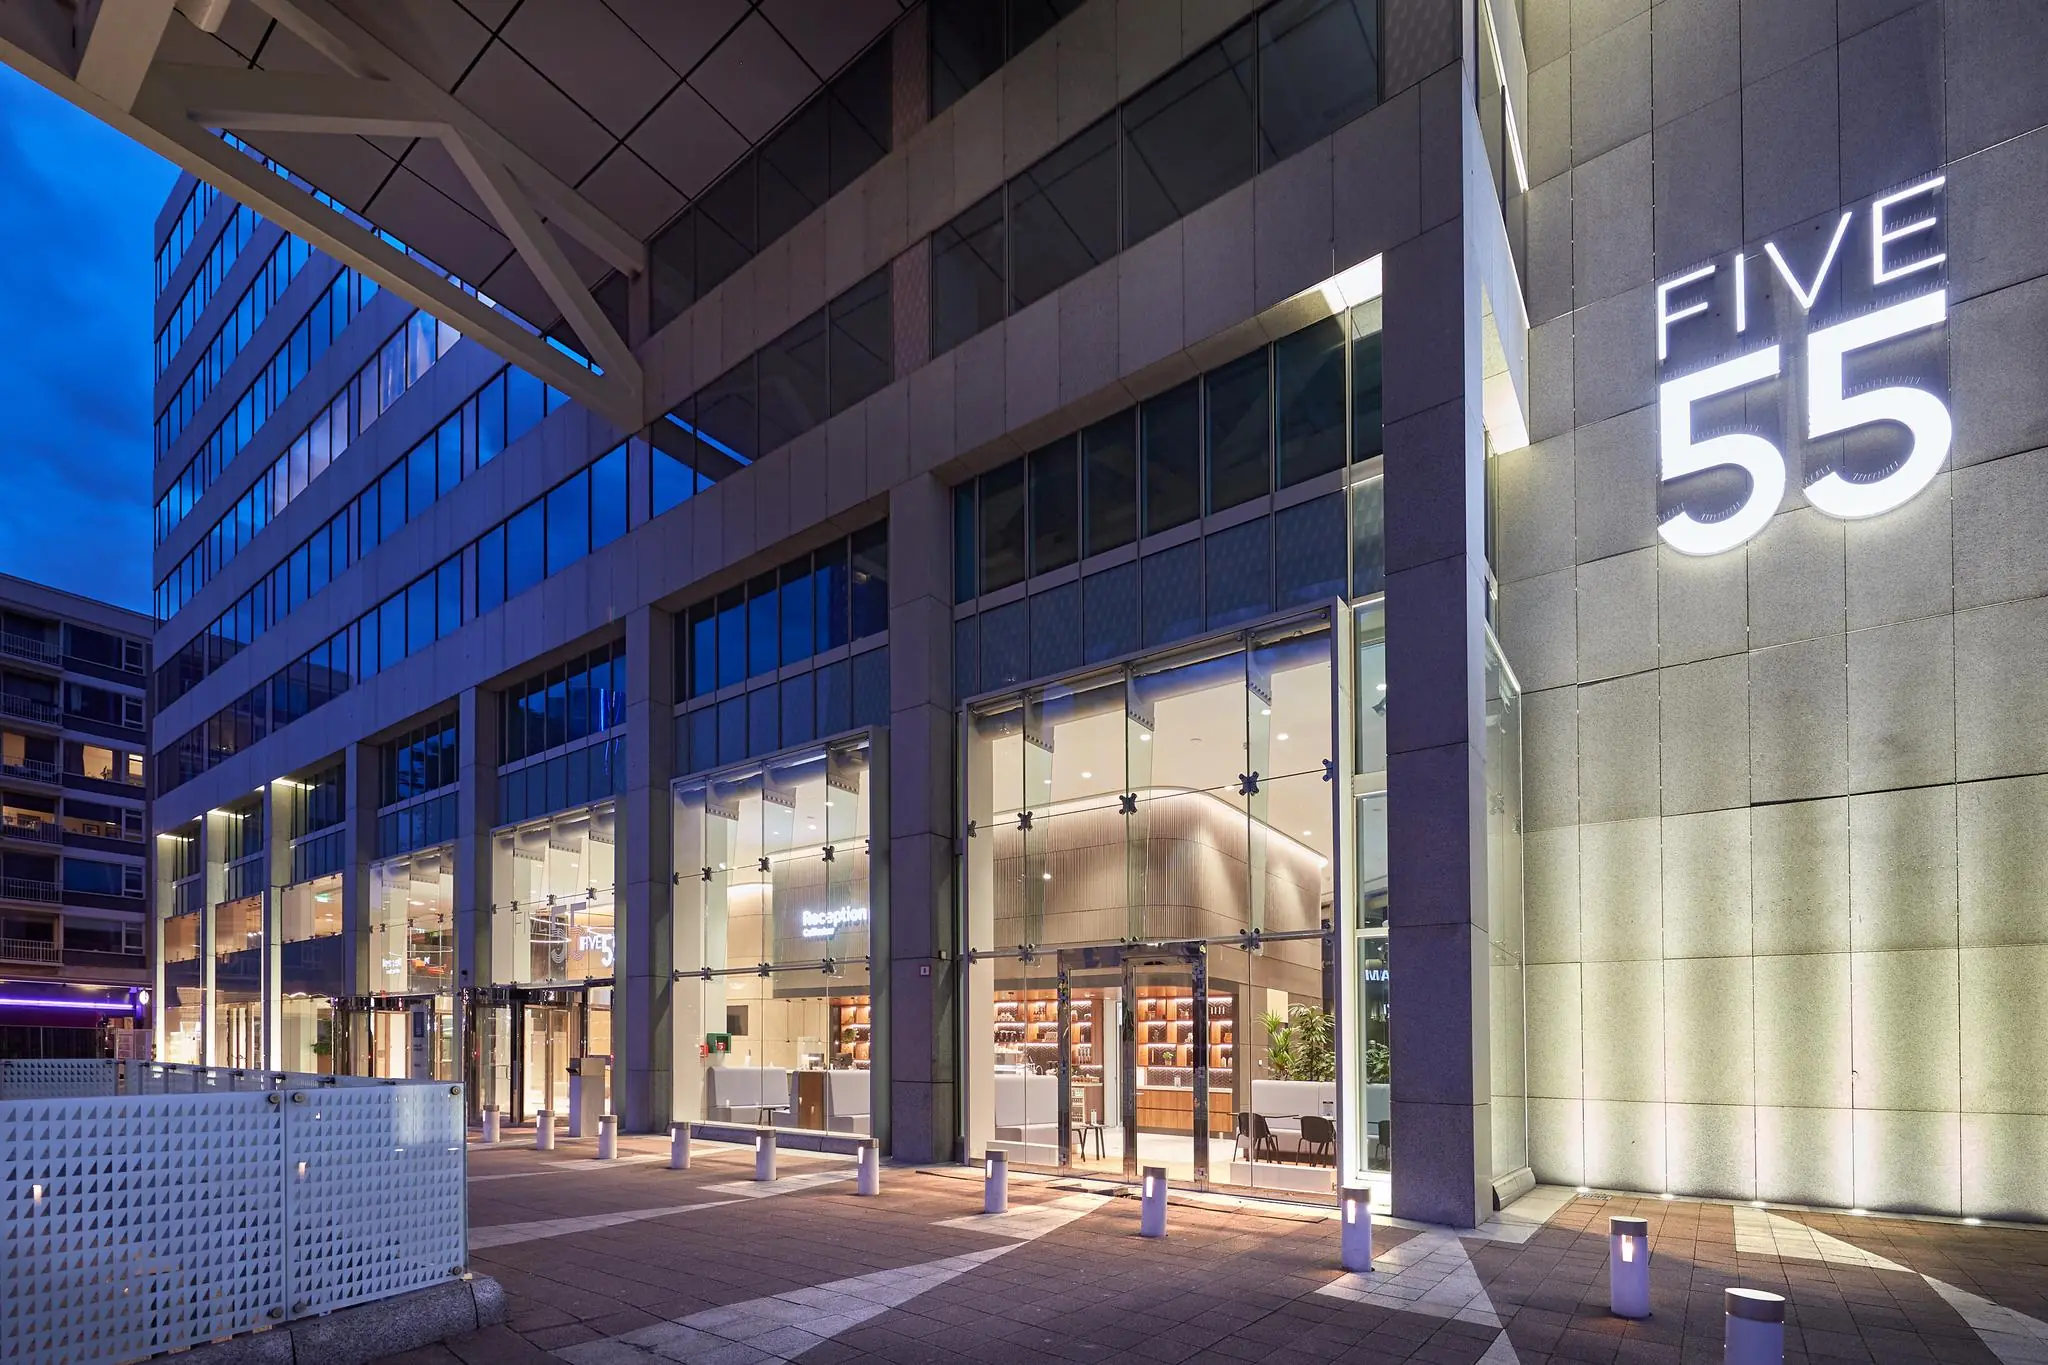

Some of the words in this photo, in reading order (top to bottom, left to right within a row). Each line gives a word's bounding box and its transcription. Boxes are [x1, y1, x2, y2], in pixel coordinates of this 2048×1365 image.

[1658, 176, 1946, 361] FIVE
[1657, 288, 1952, 556] 55
[802, 905, 867, 927] Reception
